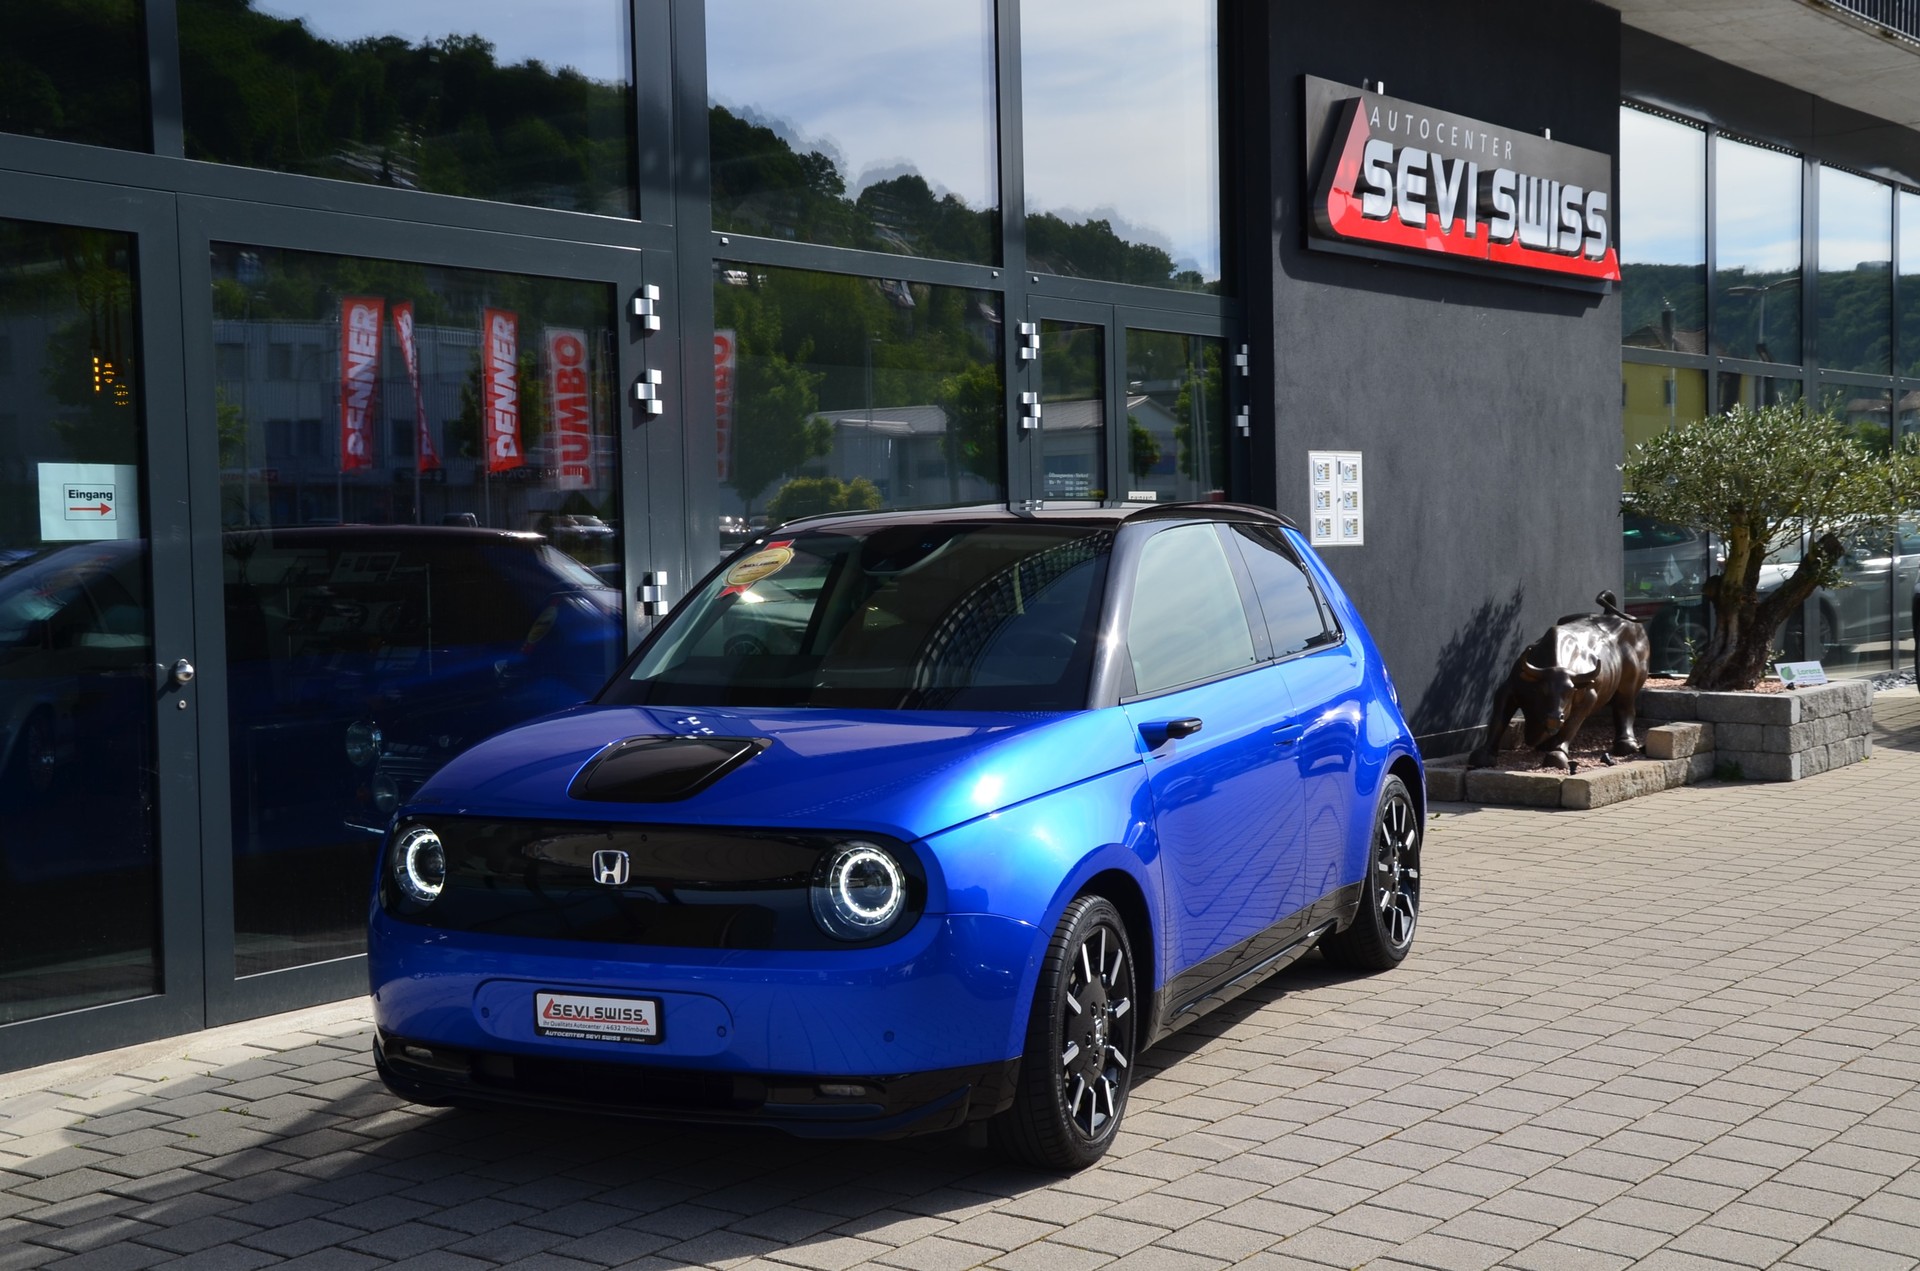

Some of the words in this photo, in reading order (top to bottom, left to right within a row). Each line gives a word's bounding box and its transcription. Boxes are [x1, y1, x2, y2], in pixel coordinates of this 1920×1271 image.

[1370, 106, 1513, 160] AUTOCENTER
[1362, 138, 1478, 234] SEVI
[1488, 167, 1608, 260] SWISS
[347, 303, 379, 456] DENNER
[492, 314, 518, 458] DENNER
[554, 331, 592, 485] JUMBO
[68, 489, 113, 501] Eingang
[552, 1003, 590, 1018] SEVI
[594, 1006, 643, 1021] SWISS
[574, 1022, 602, 1030] Autocenter
[623, 1025, 651, 1033] Trimbach
